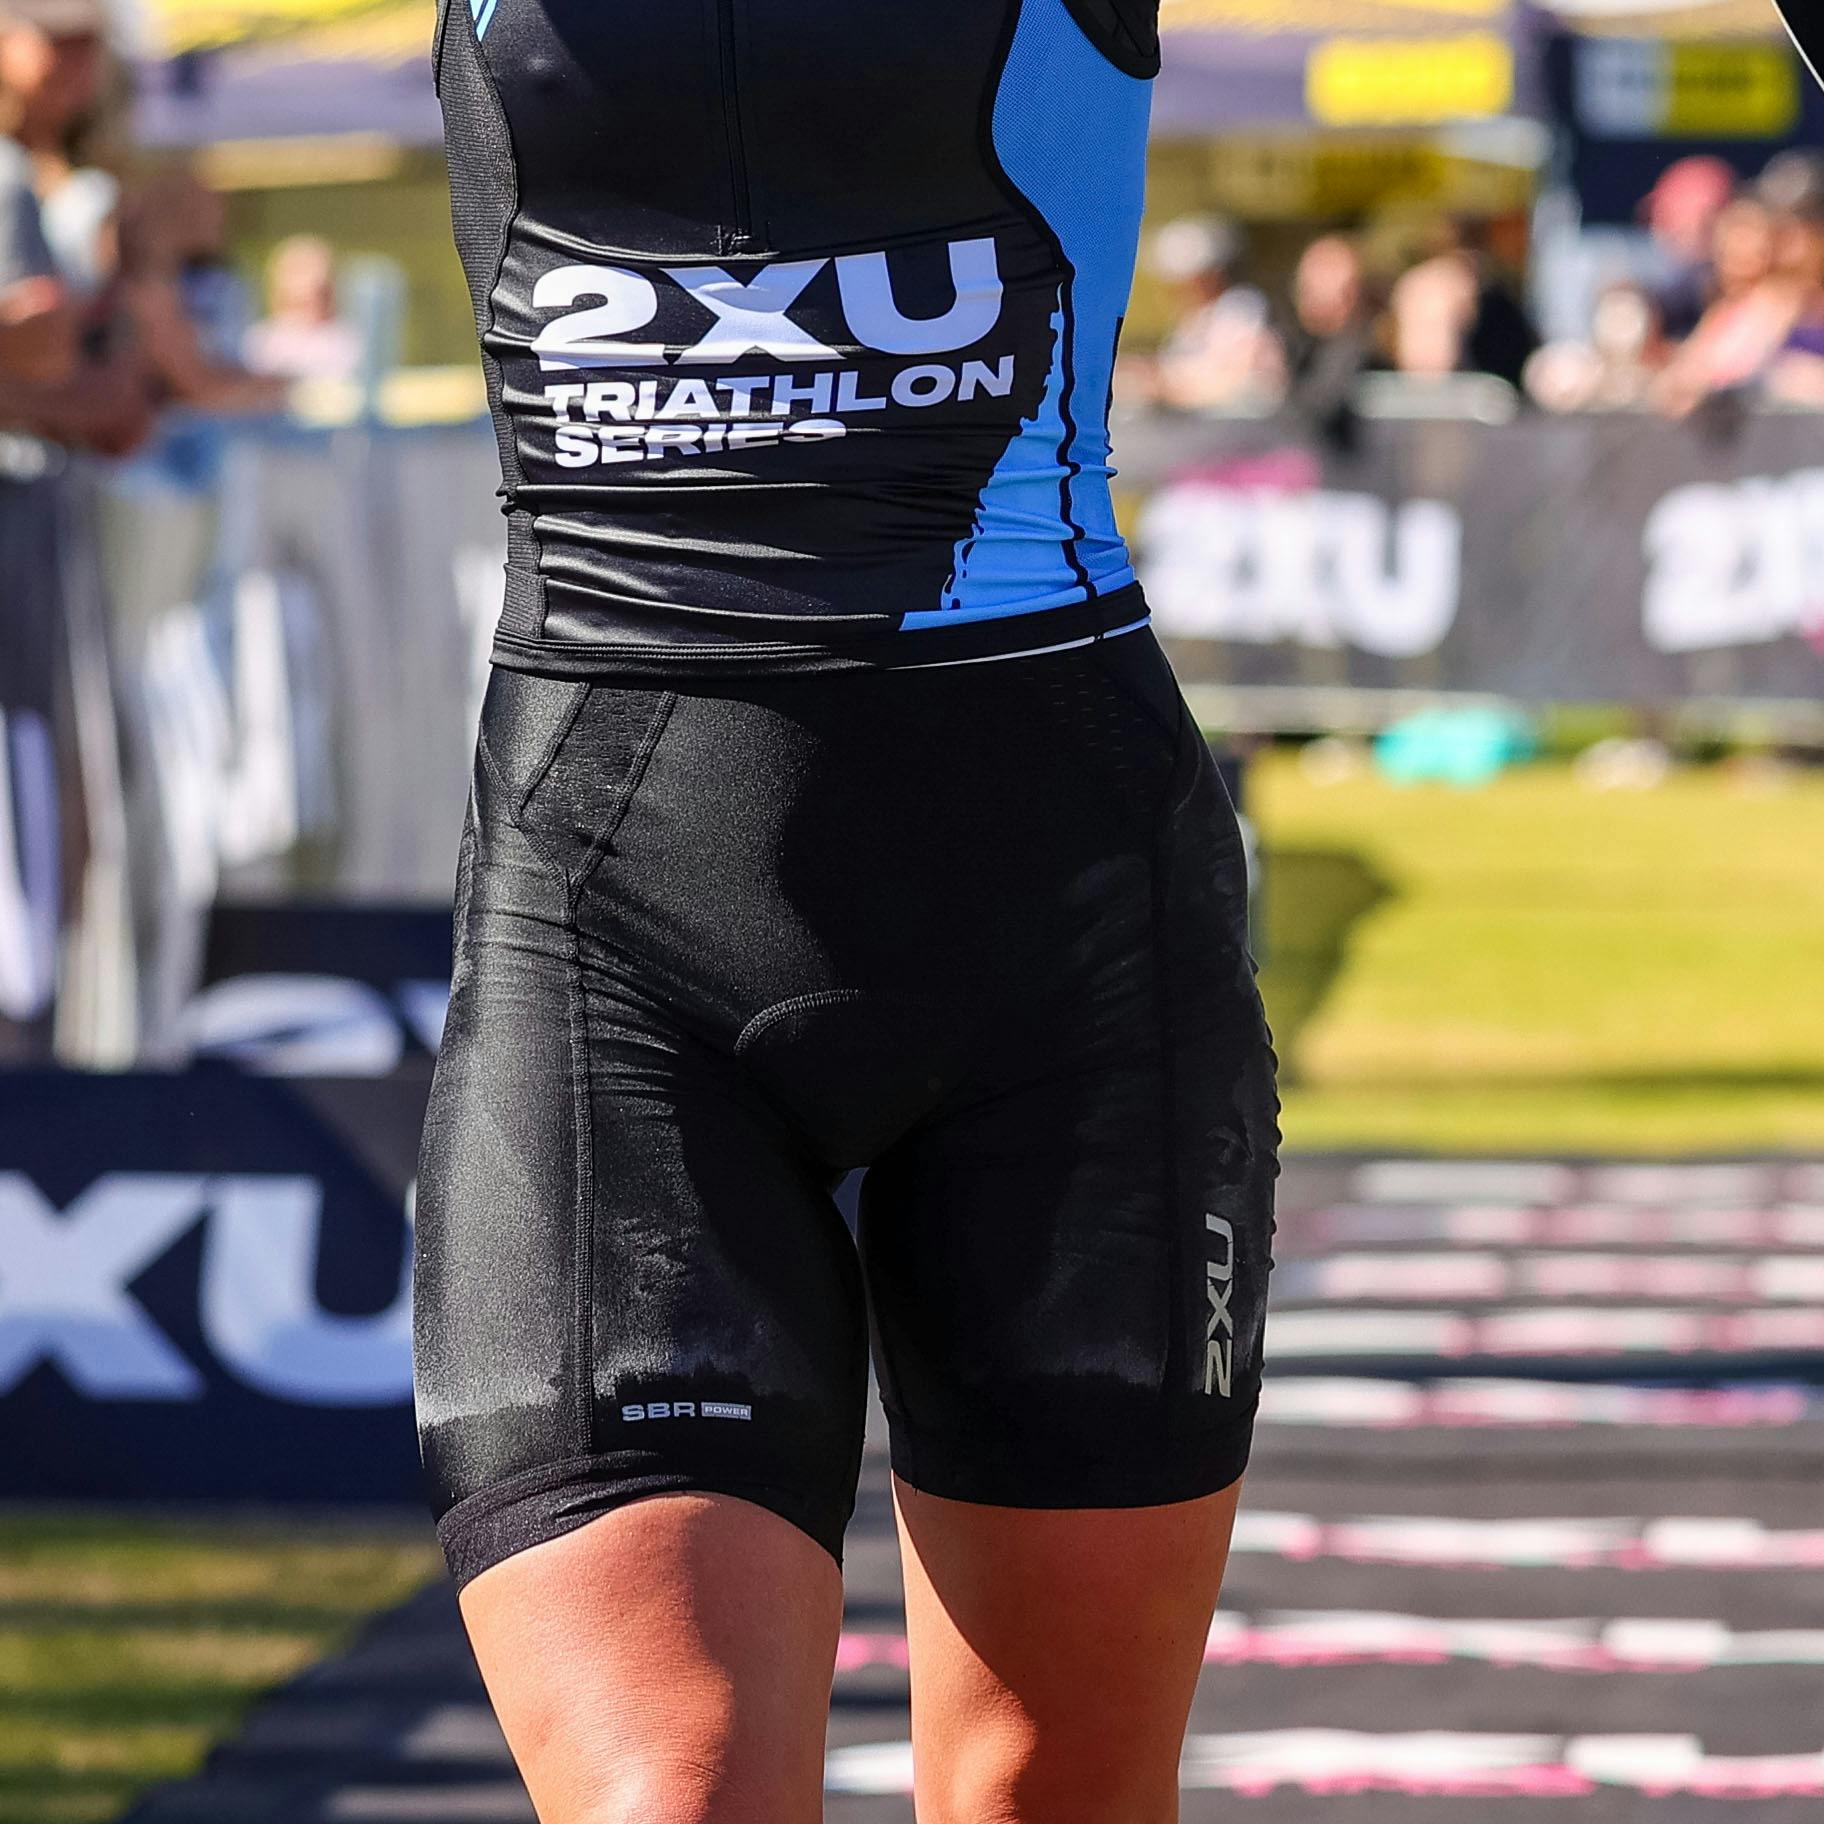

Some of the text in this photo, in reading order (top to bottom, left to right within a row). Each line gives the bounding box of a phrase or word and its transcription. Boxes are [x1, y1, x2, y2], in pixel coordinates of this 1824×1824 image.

[531, 237, 1003, 371] 2XU
[545, 354, 1015, 422] TRIATHLON
[554, 418, 847, 468] SERIES
[1205, 1212, 1234, 1398] 2XU
[622, 1401, 749, 1422] SBR POWER
